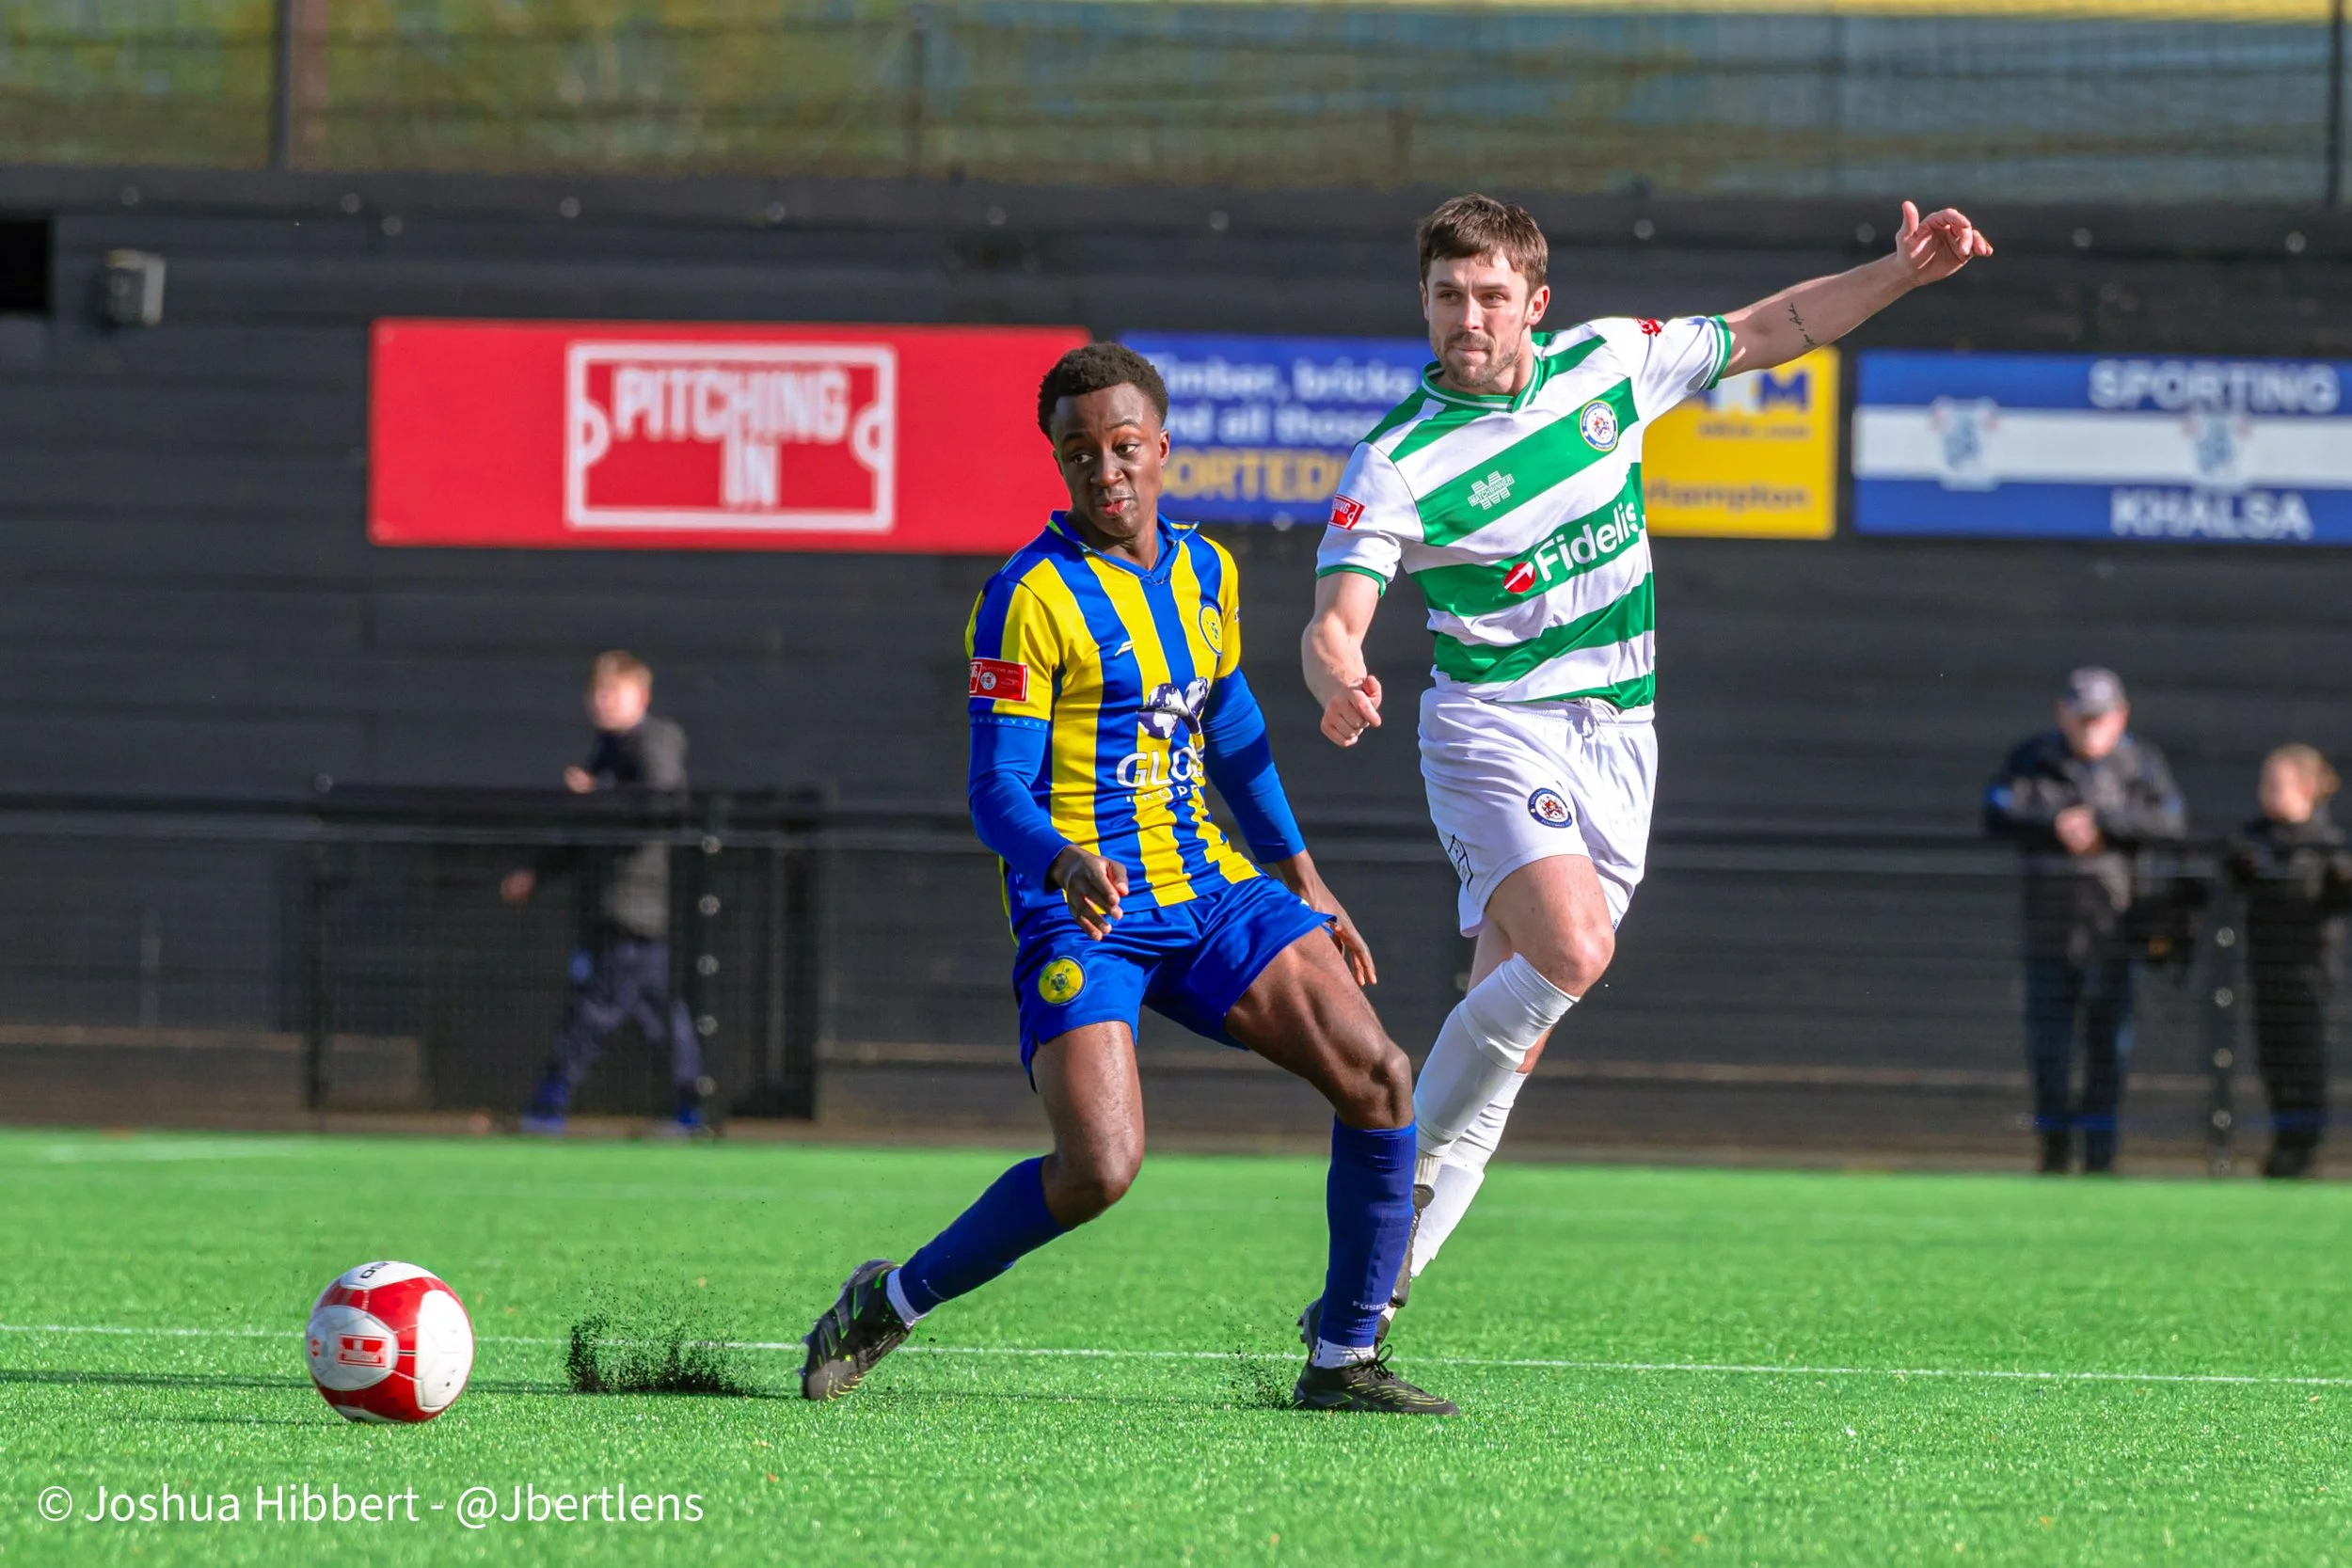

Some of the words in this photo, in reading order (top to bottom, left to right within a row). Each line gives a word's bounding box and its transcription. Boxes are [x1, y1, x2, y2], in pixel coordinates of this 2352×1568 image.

[613, 366, 846, 443] PITCHING
[2088, 361, 2340, 414] SPORTING
[721, 442, 779, 508] IN
[1641, 478, 1813, 520] hampton
[1534, 501, 1641, 582] Fidelis
[2111, 489, 2314, 539] KHALSA
